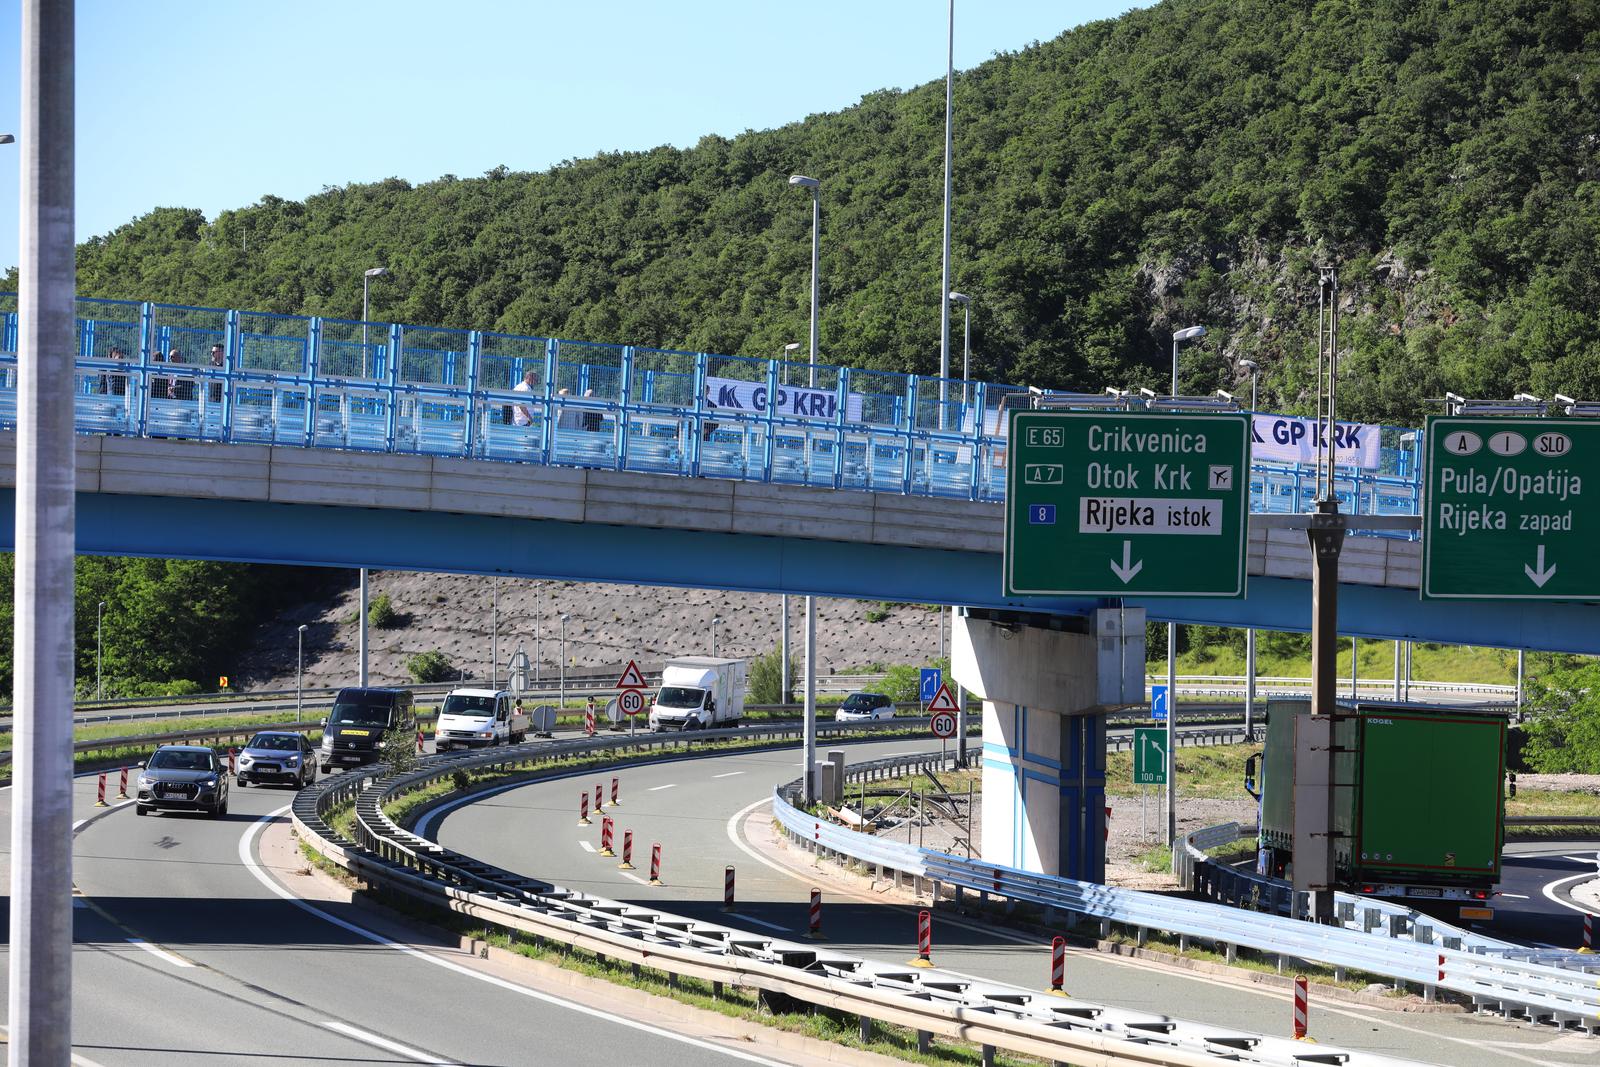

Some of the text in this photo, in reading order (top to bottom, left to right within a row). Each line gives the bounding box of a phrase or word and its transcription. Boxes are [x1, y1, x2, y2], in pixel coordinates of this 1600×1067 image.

[1029, 429, 1060, 445] E 65
[1088, 425, 1207, 453] Crikvenica
[1273, 420, 1362, 449] GP KRK
[1457, 435, 1467, 451] A
[1540, 436, 1564, 453] SLO
[1034, 468, 1054, 481] A 7
[1087, 462, 1192, 490] Otok Krk
[1441, 467, 1581, 501] Pula/Opatija
[1038, 507, 1046, 521] 8
[1086, 499, 1211, 532] Rijeka istok
[1439, 503, 1572, 536] Rijeka zapad
[624, 695, 639, 709] 60
[936, 718, 951, 732] 60
[1141, 772, 1154, 781] 100
